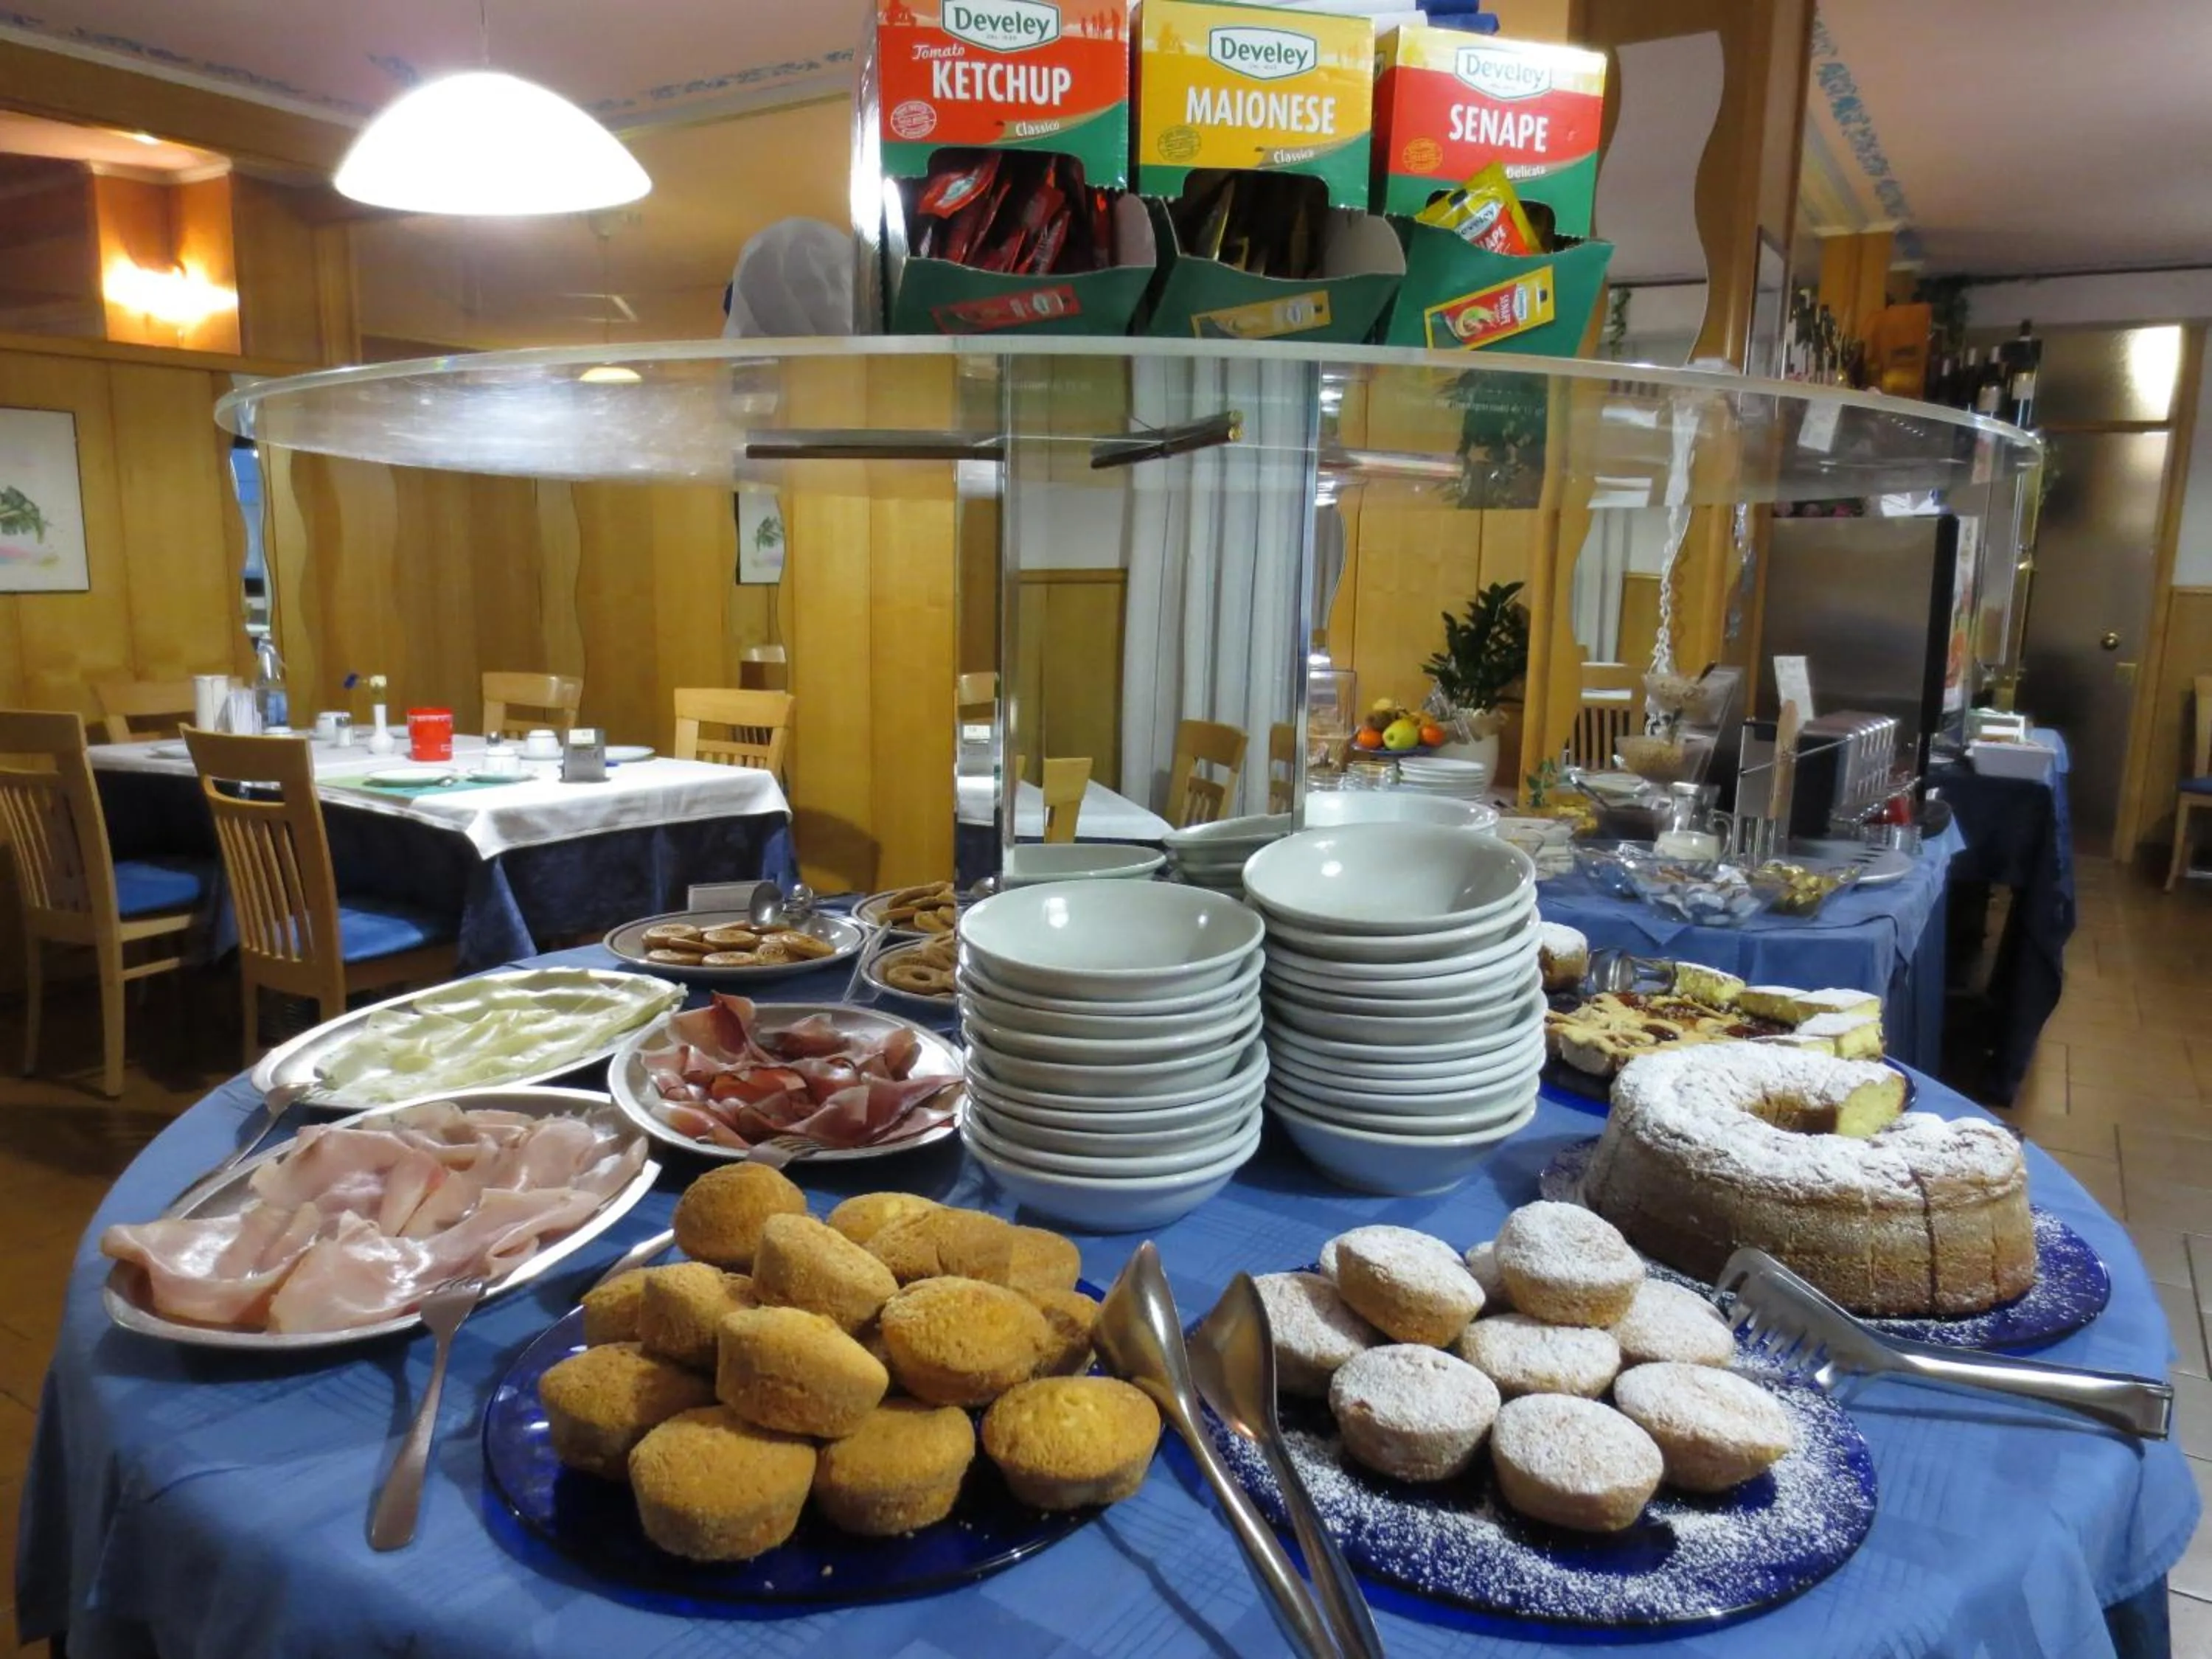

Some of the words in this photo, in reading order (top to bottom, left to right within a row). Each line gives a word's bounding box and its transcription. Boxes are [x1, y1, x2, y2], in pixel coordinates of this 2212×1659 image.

[953, 7, 1050, 41] Develey
[911, 44, 965, 60] Tomato
[1220, 37, 1309, 69] Develey
[932, 60, 1072, 106] KETCHUP
[1466, 54, 1545, 88] Develey
[1186, 86, 1336, 134] MAIONESE
[1015, 121, 1060, 136] Classico
[1449, 104, 1548, 153] SENAPE
